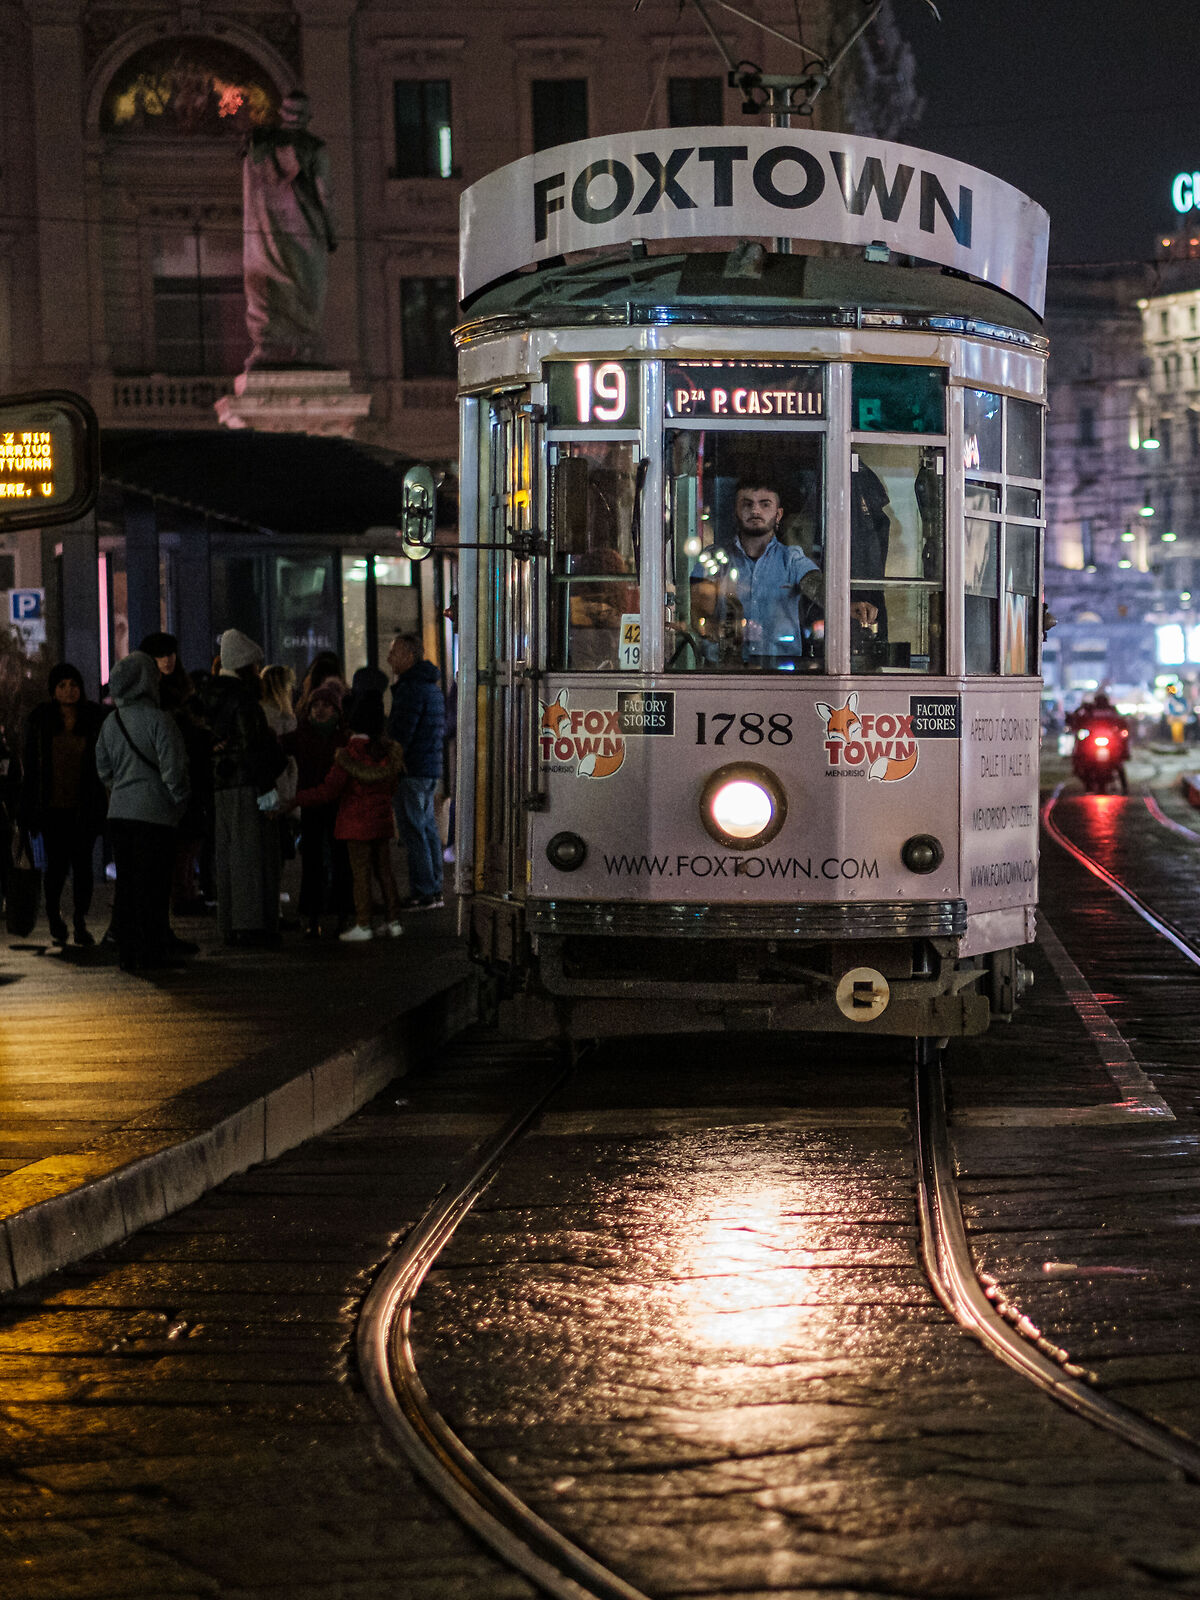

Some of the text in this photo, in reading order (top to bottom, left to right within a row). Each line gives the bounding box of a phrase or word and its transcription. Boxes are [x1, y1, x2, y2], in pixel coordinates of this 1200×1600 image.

[533, 145, 973, 249] FOXTOWN
[575, 363, 627, 423] 19
[711, 388, 728, 414] P.
[732, 388, 822, 415] CASTELLI
[22, 432, 51, 445] MIN
[19, 596, 37, 617] P
[283, 635, 331, 648] CHANEL
[624, 624, 640, 644] 42
[624, 646, 640, 665] 19
[624, 700, 667, 713] FACTORY
[917, 704, 957, 716] FACTORY
[570, 710, 621, 735] FOX
[624, 714, 666, 727] STORES
[695, 712, 794, 746] 1788
[860, 715, 915, 738] FOX
[916, 718, 956, 731] STORES
[539, 737, 622, 761] TOWN
[825, 741, 915, 765] TOWN
[824, 769, 866, 777] MENDRISIO
[604, 855, 880, 880] WWW.FOXTOWN.COM
